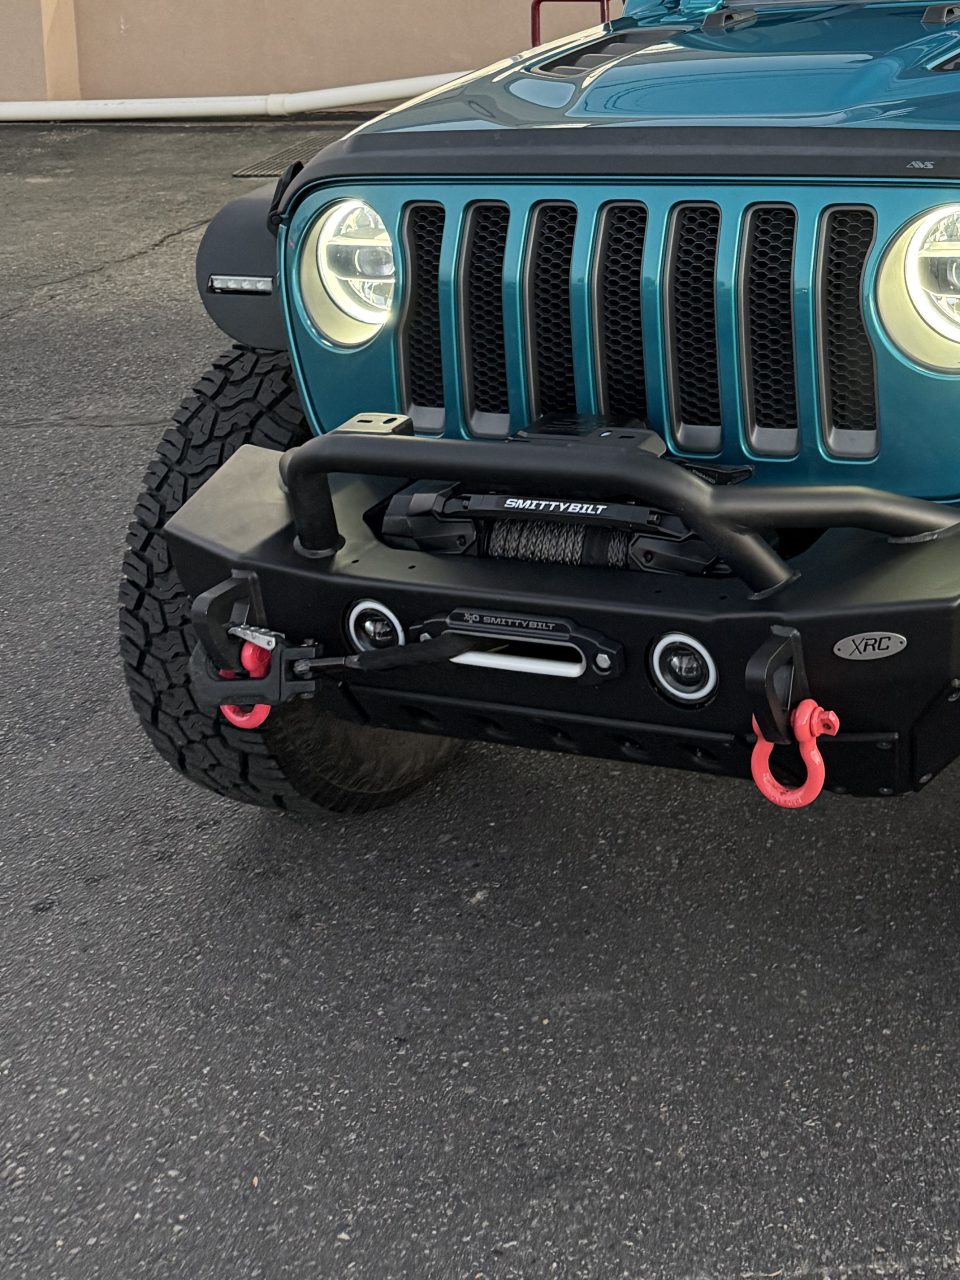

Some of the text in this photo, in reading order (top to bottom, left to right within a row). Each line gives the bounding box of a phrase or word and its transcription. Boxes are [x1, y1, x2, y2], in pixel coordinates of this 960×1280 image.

[504, 498, 607, 515] SMITTYBILT
[483, 615, 555, 631] SMITTYBILT
[848, 636, 892, 657] XRC
